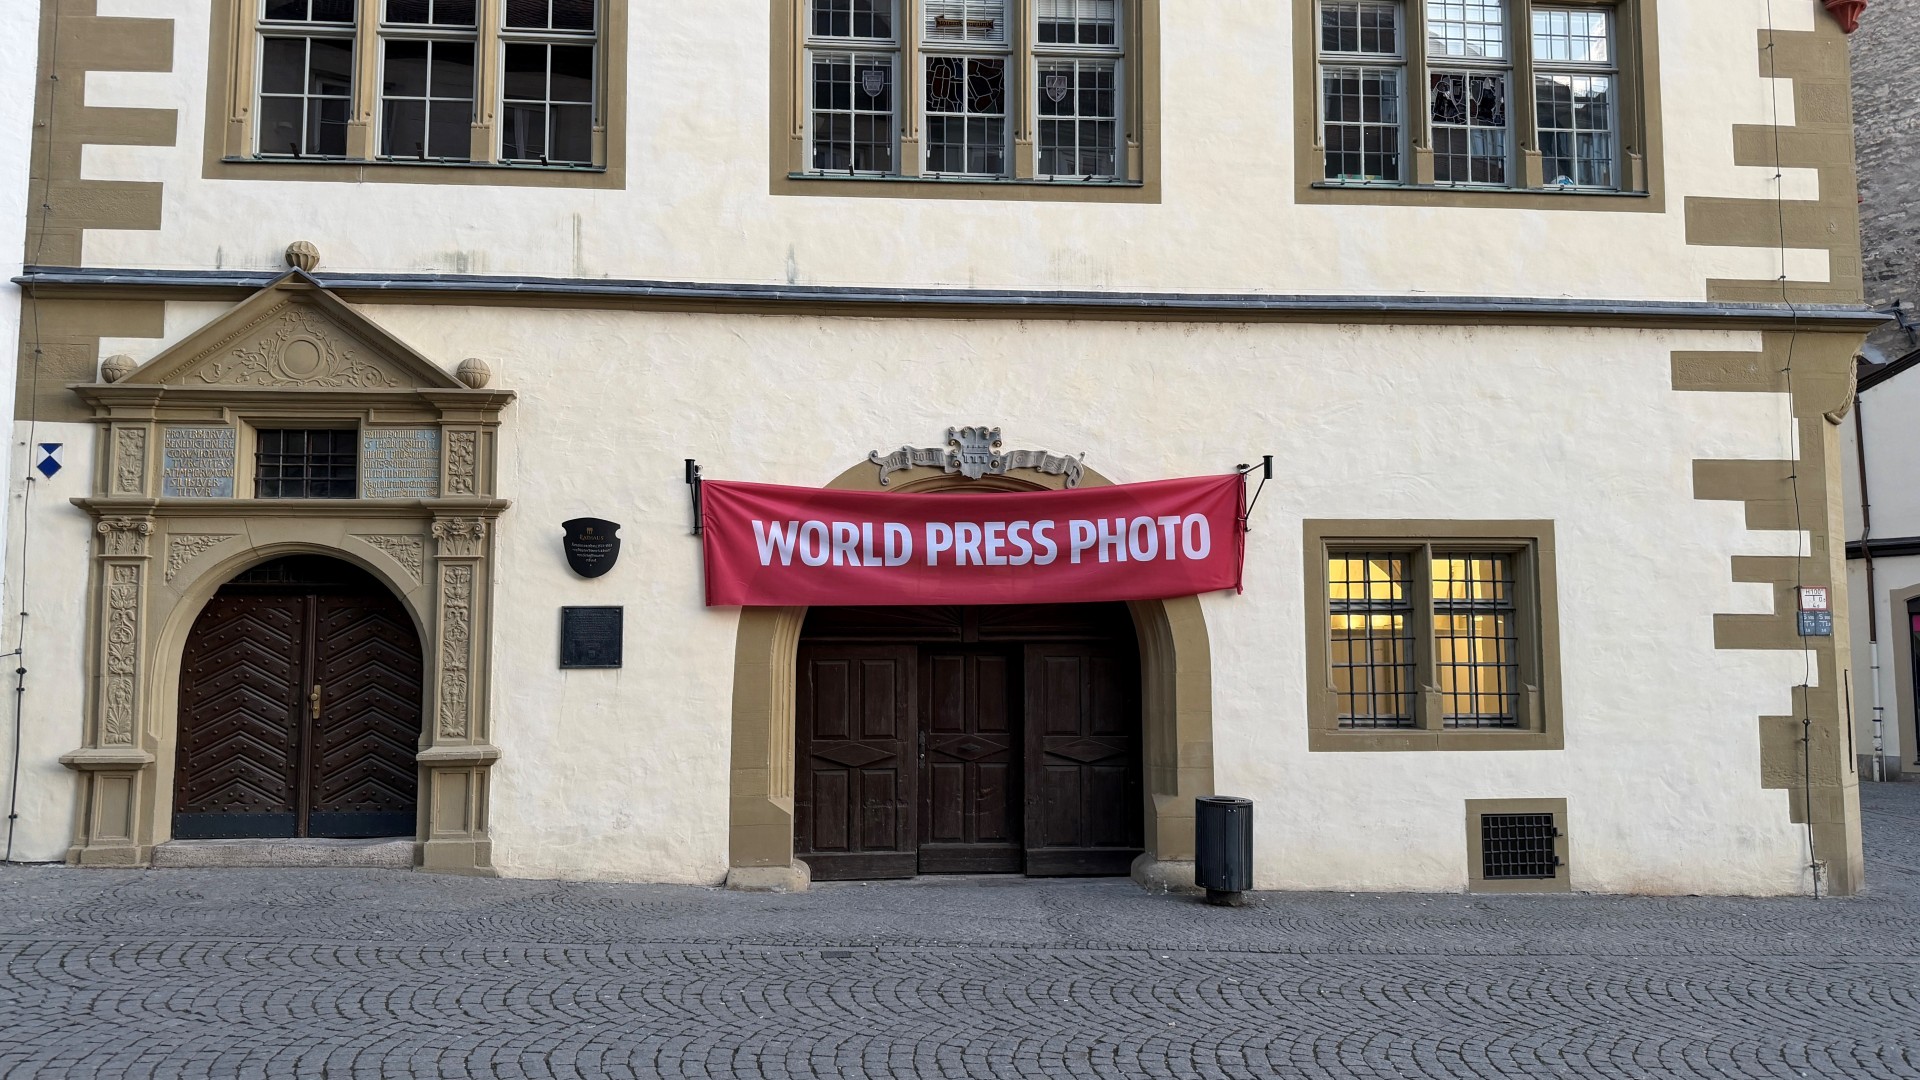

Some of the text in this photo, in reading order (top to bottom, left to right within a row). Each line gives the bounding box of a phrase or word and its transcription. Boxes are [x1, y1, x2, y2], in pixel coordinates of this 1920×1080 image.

[752, 513, 1210, 566] WORLD PRESS PHOTO
